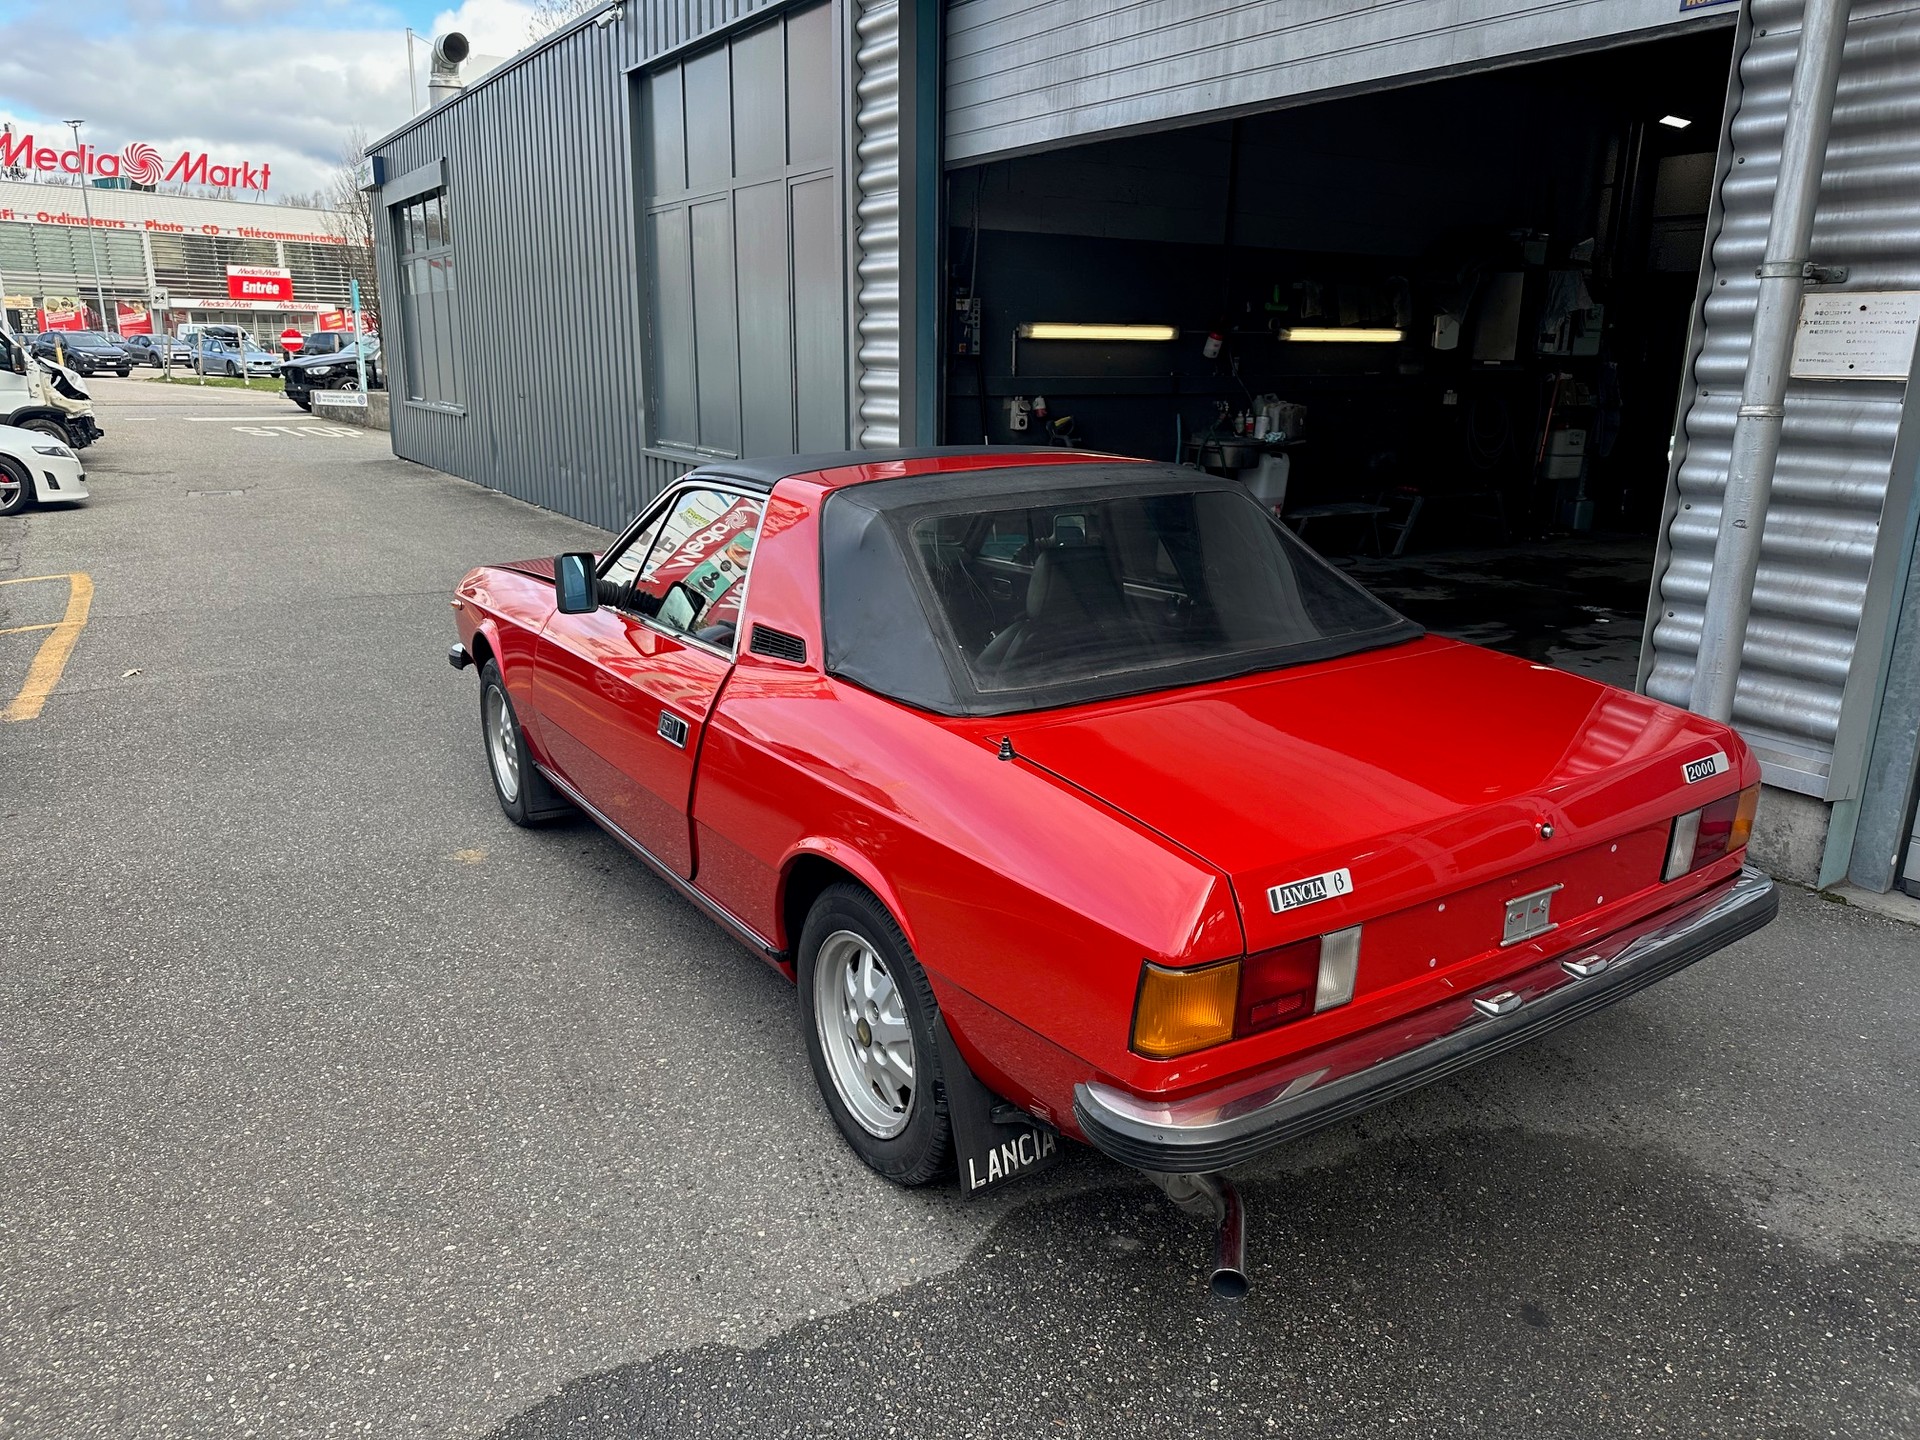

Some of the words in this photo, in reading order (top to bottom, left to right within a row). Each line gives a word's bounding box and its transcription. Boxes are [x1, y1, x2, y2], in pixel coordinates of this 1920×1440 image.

[0, 132, 120, 177] Media
[164, 151, 271, 191] Markt
[36, 211, 126, 228] Ordinateurs
[145, 219, 184, 233] Photo
[202, 224, 220, 235] CD
[237, 226, 347, 245] Télécommunication
[237, 267, 258, 276] Media
[242, 281, 280, 295] Entrée
[232, 426, 364, 438] STOP
[1688, 760, 1714, 780] 2000
[1275, 877, 1327, 911] LANCIA
[968, 1129, 1057, 1190] LANCIA
